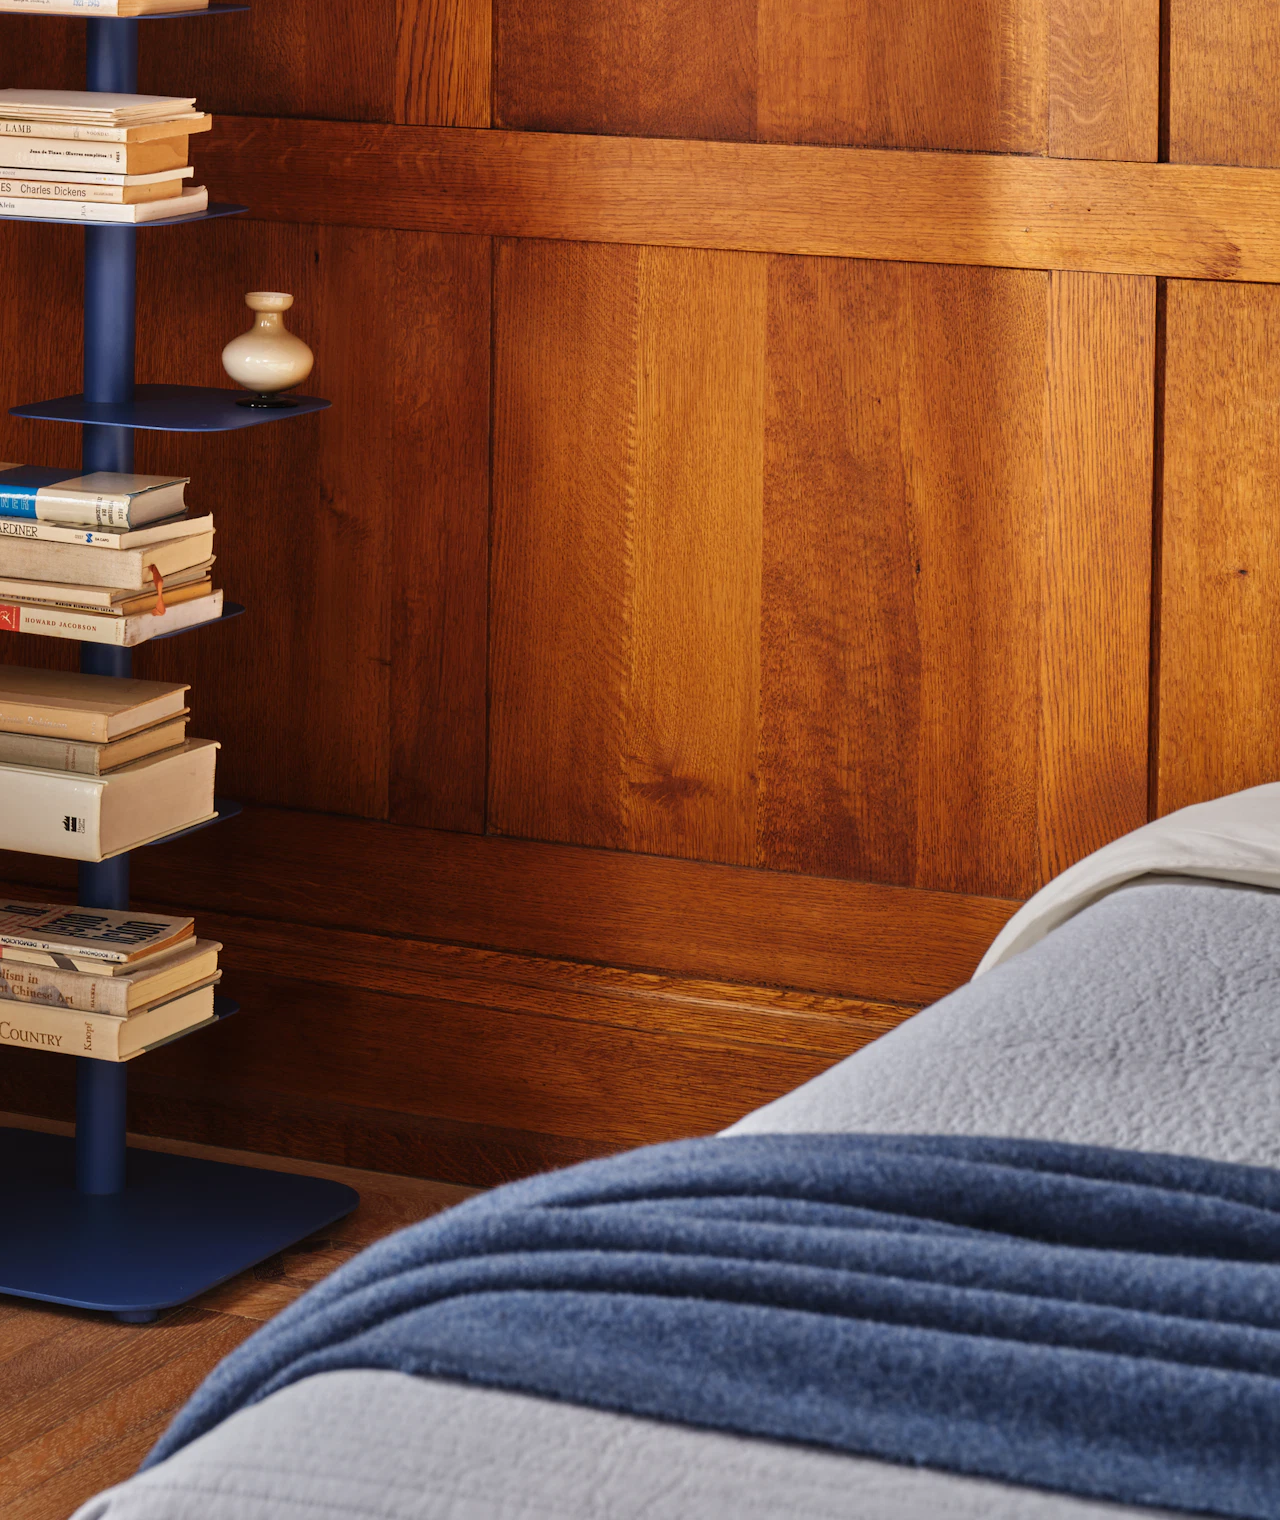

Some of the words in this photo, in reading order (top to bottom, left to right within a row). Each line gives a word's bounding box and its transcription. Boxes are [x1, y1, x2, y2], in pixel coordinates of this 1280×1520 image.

[5, 123, 32, 133] LAMB
[20, 183, 51, 195] Charles
[54, 186, 87, 197] Dickens
[24, 617, 57, 627] HOWARD
[59, 622, 98, 632] JACOBSON
[27, 715, 68, 730] Robinson
[1, 937, 38, 948] DEMOLICIÓN
[28, 975, 39, 985] in
[12, 984, 53, 1001] Chinese
[56, 994, 74, 1005] Art
[83, 1021, 93, 1051] Knopf
